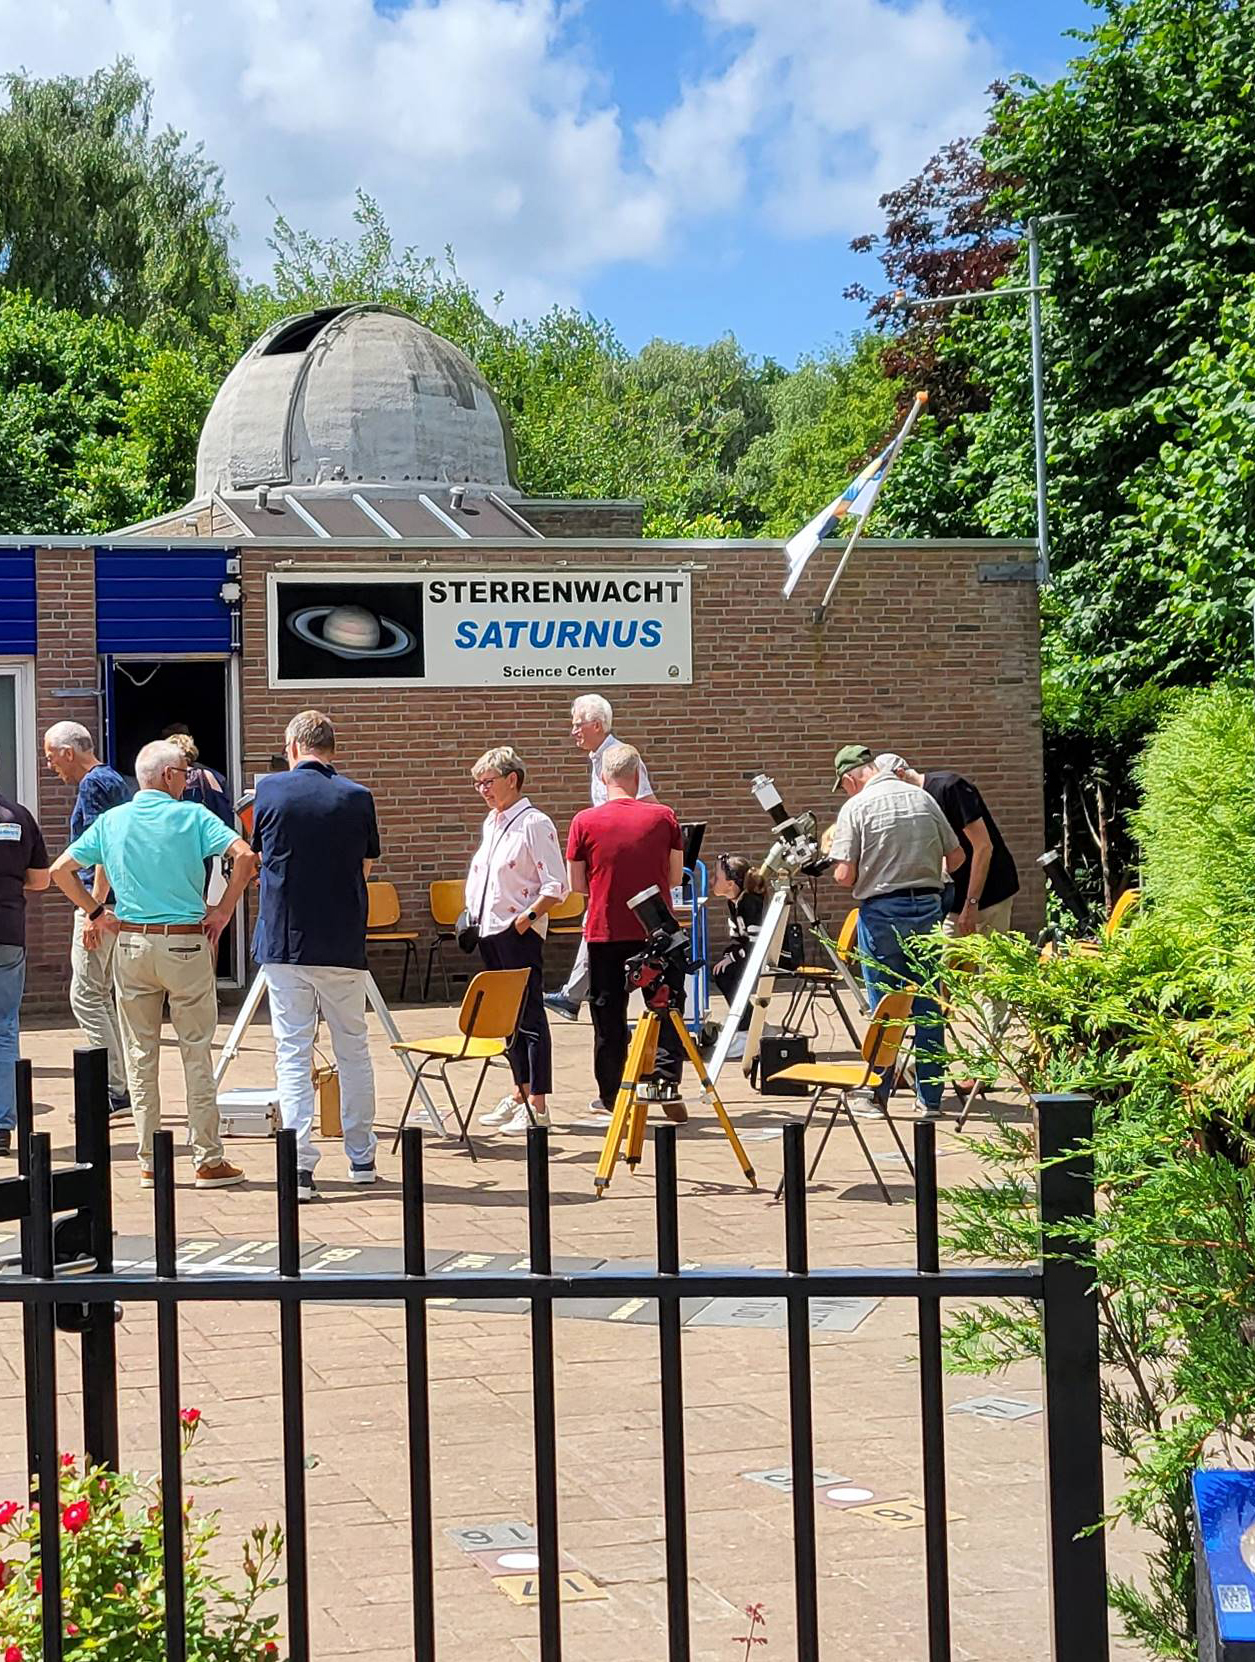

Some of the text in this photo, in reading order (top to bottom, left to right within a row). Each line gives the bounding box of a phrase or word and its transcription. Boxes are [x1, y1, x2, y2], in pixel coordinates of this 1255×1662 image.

[428, 580, 684, 604] STERRENWACHT
[454, 619, 663, 649] SATURNUS
[503, 663, 617, 679] Science Center
